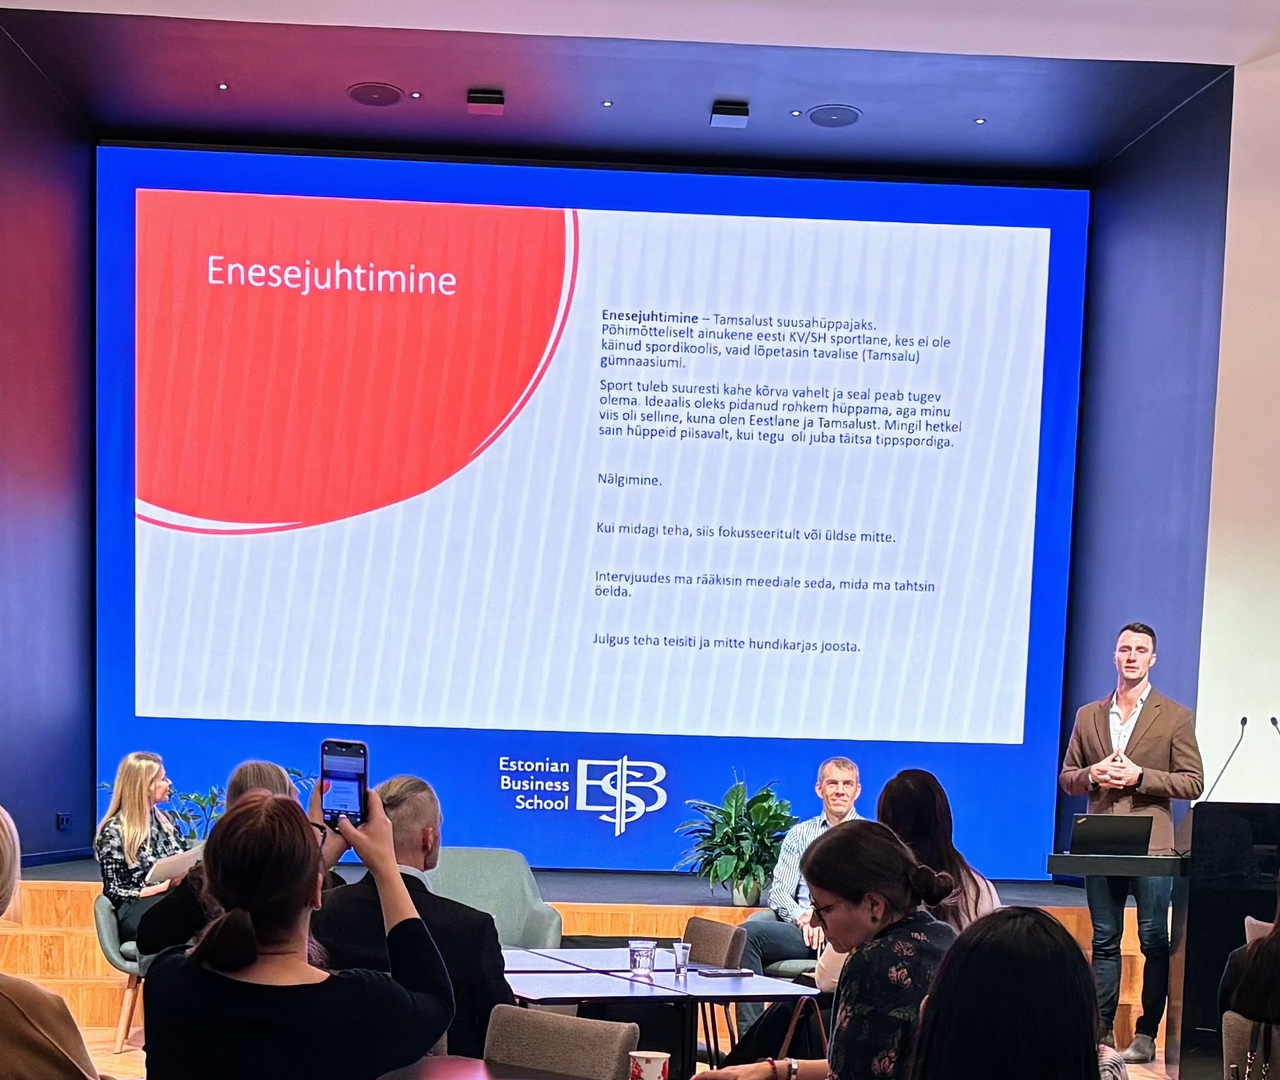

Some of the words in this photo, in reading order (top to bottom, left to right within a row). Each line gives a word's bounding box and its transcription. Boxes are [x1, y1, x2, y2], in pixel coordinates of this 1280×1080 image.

[207, 253, 458, 297] Enesejuhtimine
[602, 308, 698, 324] Enesejuhtimine
[712, 313, 772, 327] Tamsalust
[776, 316, 876, 332] suusahüppajaks.
[601, 323, 694, 338] Põhimõtteliselt
[697, 326, 752, 340] ainukene
[756, 331, 785, 342] eesti
[789, 330, 826, 343] KV/SH
[830, 333, 890, 349] sportlane,
[894, 333, 914, 346] kes
[917, 335, 928, 347] ei
[931, 335, 950, 348] ole
[600, 353, 685, 368] gümnaasiumi.
[601, 337, 641, 351] käinud
[645, 340, 721, 356] spordikoolis,
[725, 343, 750, 355] vaid
[754, 343, 809, 359] lõpetasin
[812, 347, 858, 359] tavalise
[862, 348, 919, 364] (Tamsalu)
[599, 379, 632, 395] Sport
[636, 379, 668, 392] tuleb
[671, 382, 719, 394] suuresti
[723, 382, 752, 396] kahe
[755, 383, 788, 397] kõrva
[792, 385, 829, 398] vahelt
[832, 387, 843, 403] ja
[846, 387, 870, 400] seal
[874, 388, 904, 403] peab
[907, 391, 941, 404] tugev
[599, 391, 640, 406] olema.
[644, 394, 690, 408] Ideaalis
[693, 396, 725, 409] oleks
[728, 398, 778, 413] pidanud
[782, 400, 828, 413] rohkem
[831, 399, 892, 418] hüppama,
[895, 406, 916, 418] aga
[920, 404, 950, 417] minu
[598, 408, 618, 420] viis
[622, 408, 636, 421] oli
[640, 409, 682, 424] selline,
[686, 410, 715, 424] kuna
[718, 411, 745, 425] olen
[749, 413, 799, 427] Eestlane
[803, 416, 813, 430] ja
[817, 416, 880, 430] Tamsalust.
[884, 419, 921, 434] Mingil
[925, 419, 961, 432] hetkel
[598, 424, 622, 435] sain
[626, 423, 676, 439] hüppeid
[680, 426, 732, 441] piisavalt,
[736, 427, 753, 440] kui
[757, 430, 784, 444] tegu
[790, 430, 806, 442] oli
[809, 430, 835, 445] juba
[838, 432, 871, 444] täitsa
[875, 433, 953, 449] tippspordiga.
[598, 472, 662, 487] Nälgimine.
[596, 521, 614, 533] Kui
[618, 522, 658, 538] midagi
[662, 523, 692, 537] teha,
[696, 524, 714, 537] siis
[718, 525, 800, 540] fokusseeritult
[803, 528, 821, 540] või
[825, 529, 856, 541] üldse
[860, 530, 895, 542] mitte.
[594, 584, 631, 597] õelda.
[595, 570, 670, 585] Intervjuudes
[674, 576, 692, 584] ma
[696, 573, 742, 586] rääkisin
[745, 575, 800, 588] meediale
[804, 576, 835, 590] seda,
[839, 577, 868, 590] mida
[872, 581, 890, 590] ma
[894, 579, 934, 592] tahtsin
[592, 632, 629, 647] Julgus
[633, 634, 659, 646] teha
[663, 635, 696, 647] teisiti
[699, 635, 709, 650] ja
[713, 636, 745, 648] mitte
[748, 636, 817, 653] hundikarjas
[821, 640, 860, 653] joosta.
[499, 756, 570, 773] Estonian
[500, 776, 570, 792] Business
[515, 795, 569, 811] School
